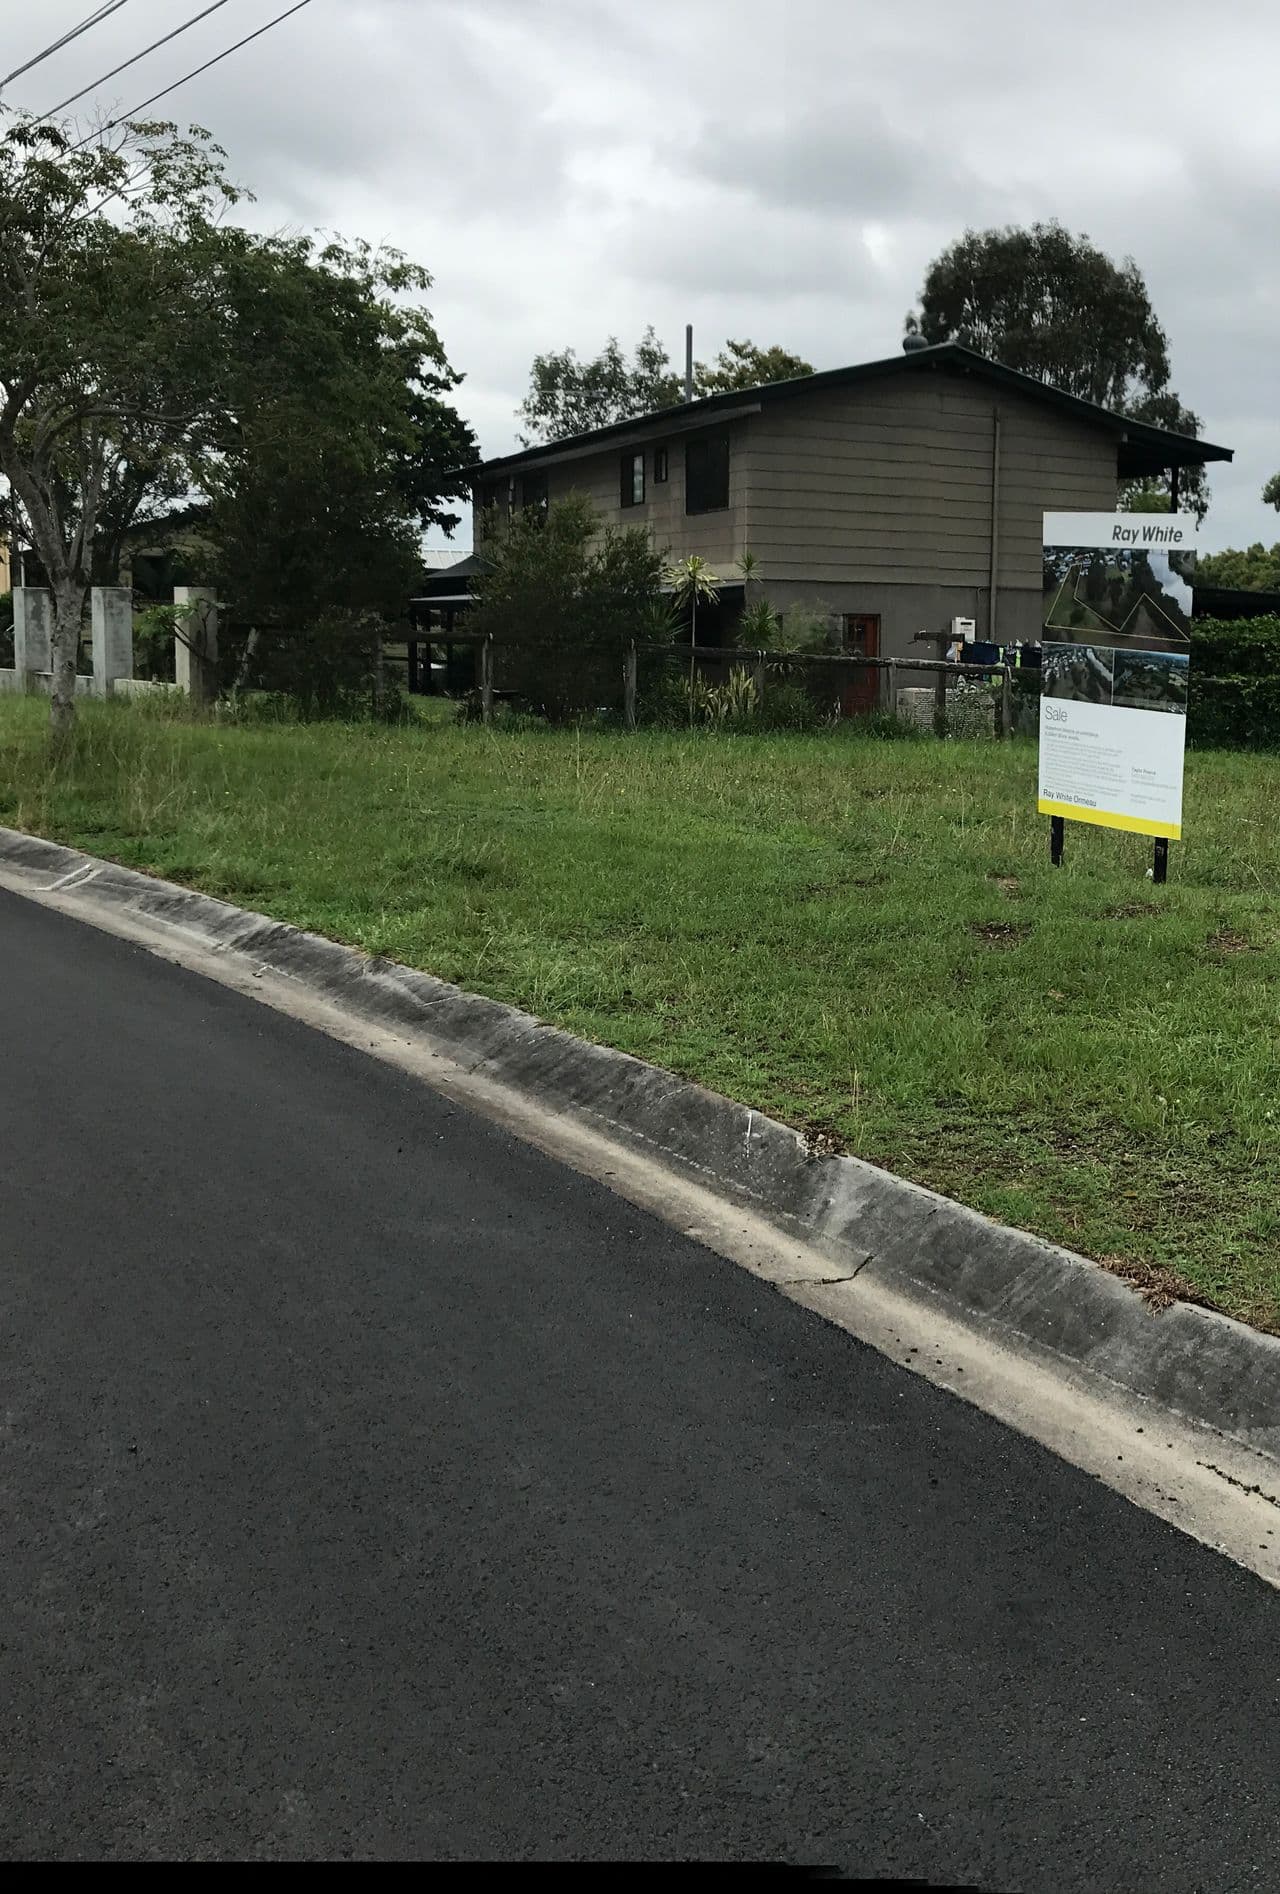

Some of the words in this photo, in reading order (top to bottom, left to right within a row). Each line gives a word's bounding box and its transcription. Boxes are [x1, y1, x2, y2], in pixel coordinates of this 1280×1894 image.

[1112, 525, 1139, 544] Ray
[1143, 526, 1183, 542] White
[1045, 705, 1068, 721] Sale
[1043, 789, 1055, 799] Ray
[1056, 791, 1073, 801] White
[1074, 795, 1097, 806] Ormeau
